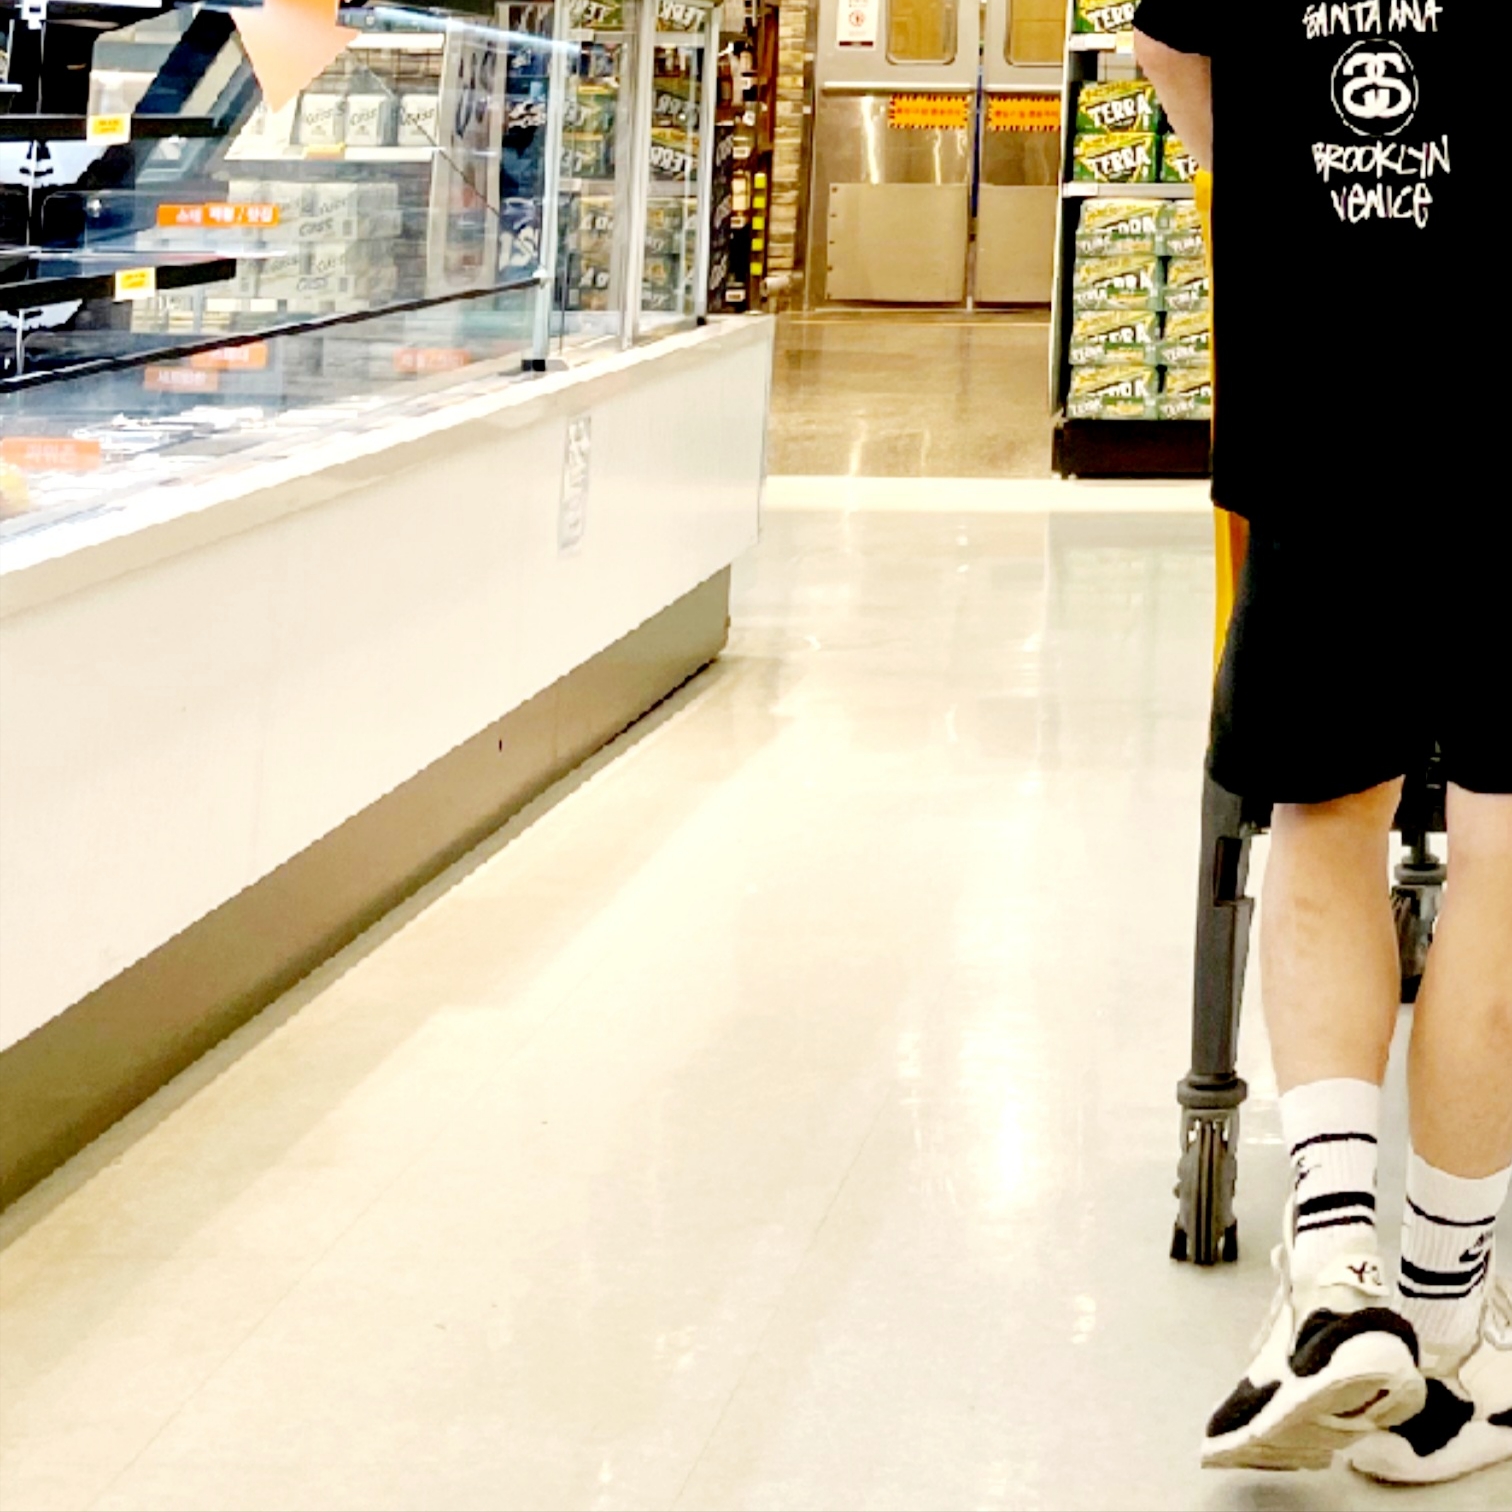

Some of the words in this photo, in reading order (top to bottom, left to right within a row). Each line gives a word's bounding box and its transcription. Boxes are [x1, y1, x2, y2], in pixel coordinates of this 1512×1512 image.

[1087, 93, 1153, 129] TERRA
[1087, 145, 1152, 179] TERRA
[1312, 135, 1450, 181] BROOKLYN
